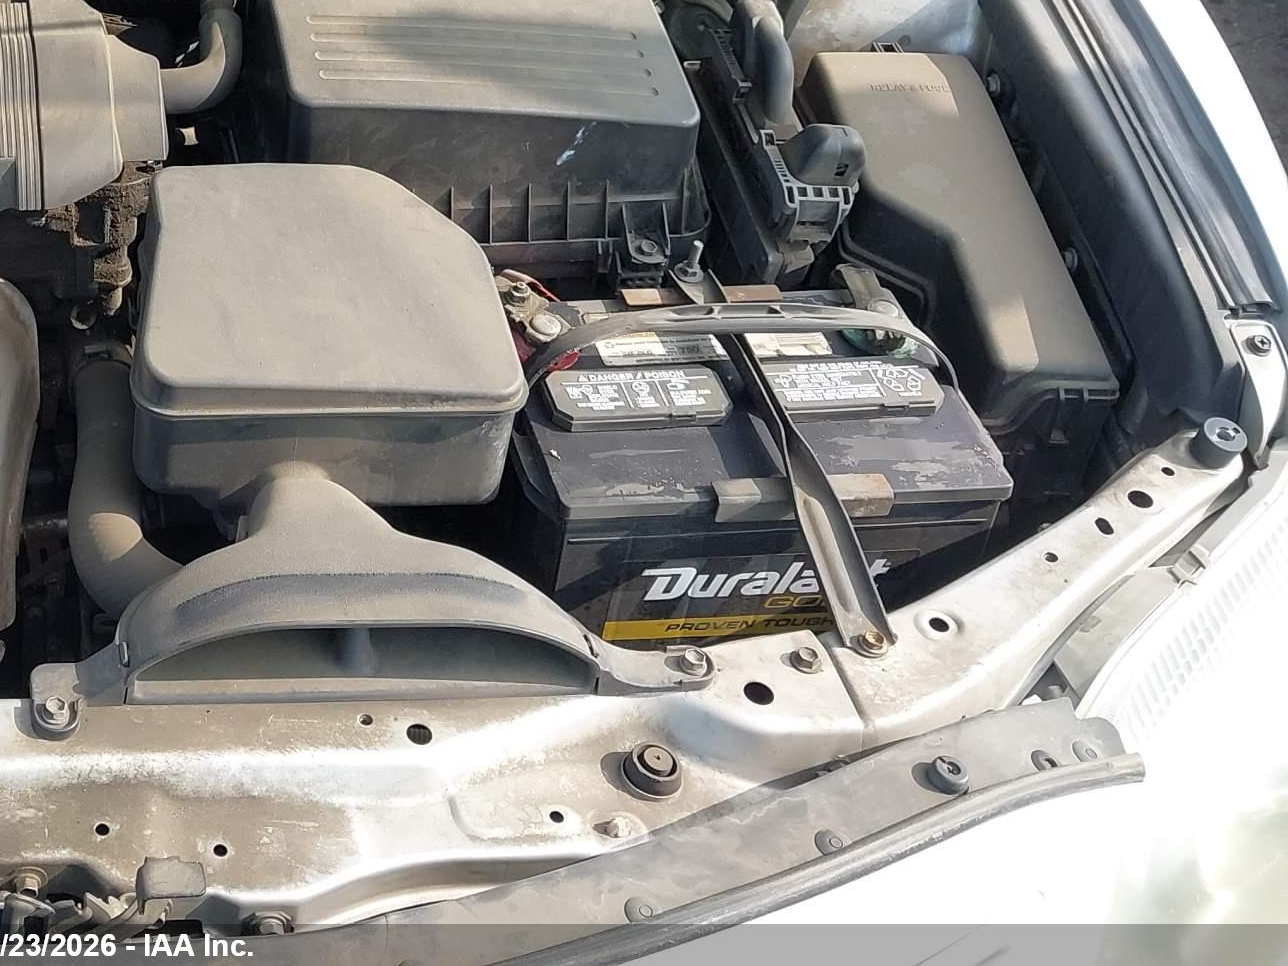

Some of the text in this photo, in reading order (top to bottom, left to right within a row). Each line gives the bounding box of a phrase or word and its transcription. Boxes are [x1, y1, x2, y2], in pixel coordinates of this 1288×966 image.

[588, 373, 635, 382] DANGER
[645, 369, 686, 380] POISON
[664, 618, 756, 633] PROVEN
